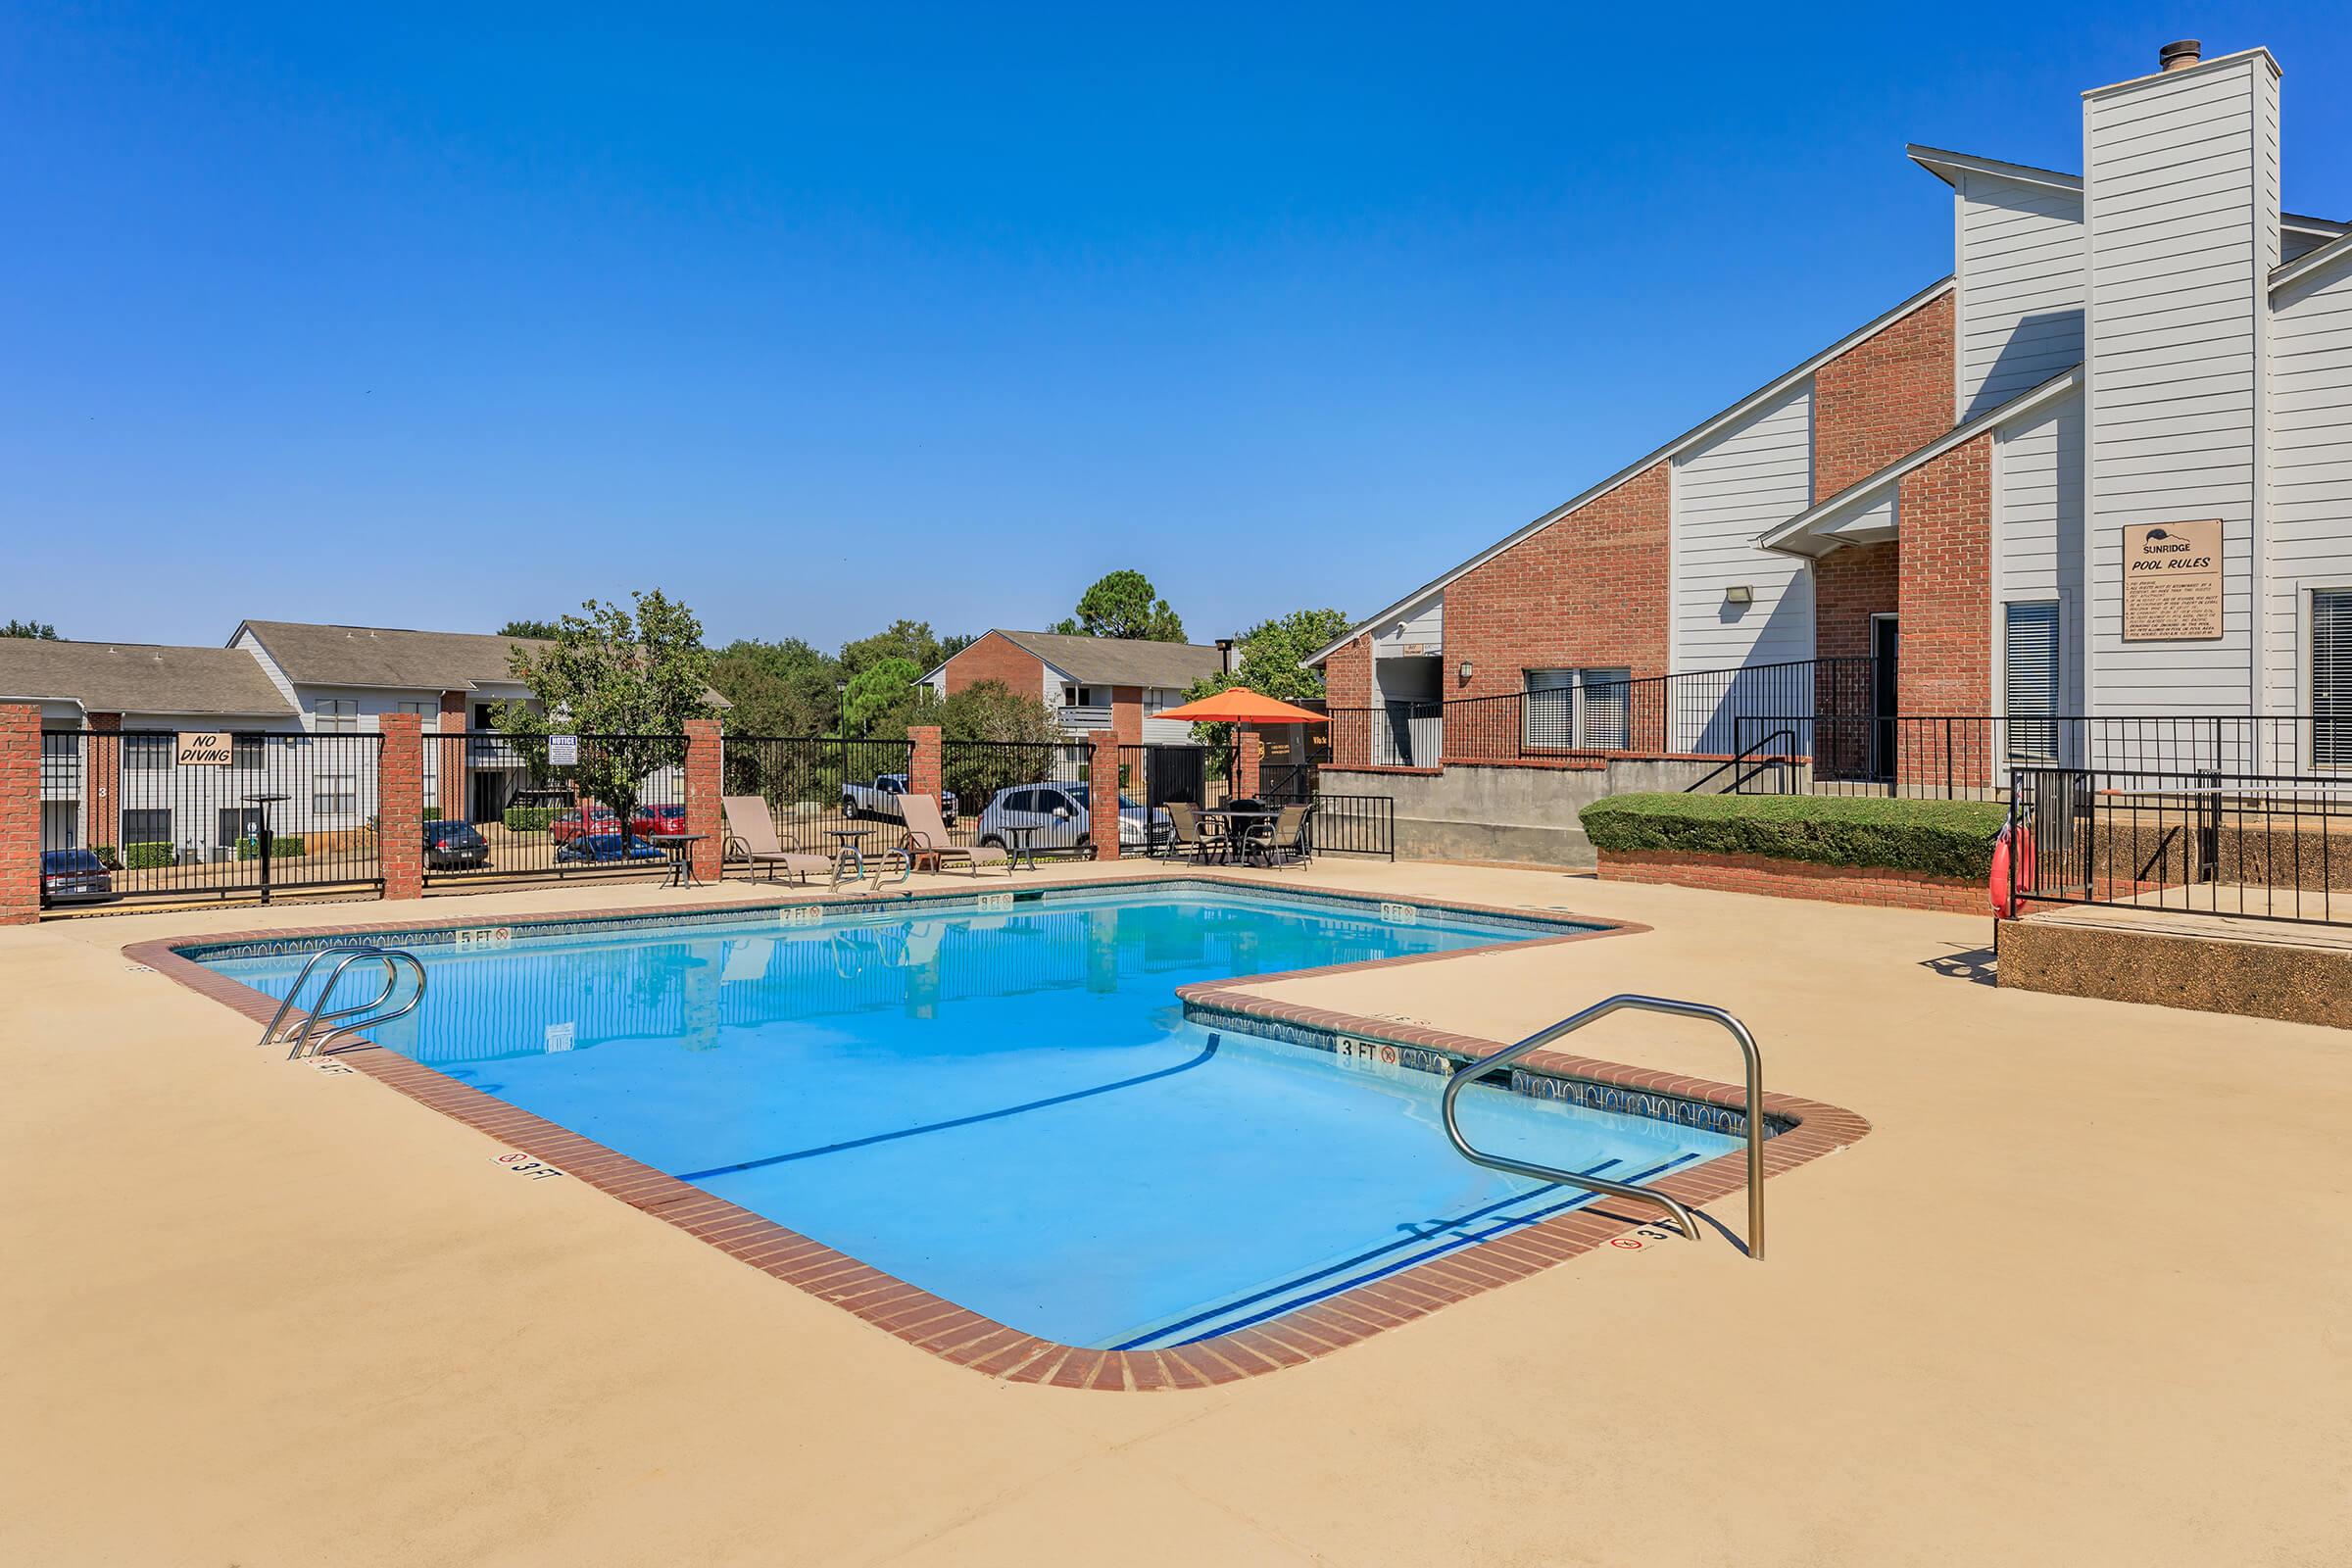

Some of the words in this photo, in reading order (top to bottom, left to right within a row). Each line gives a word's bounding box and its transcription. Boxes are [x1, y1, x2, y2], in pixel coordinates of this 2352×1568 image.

[2143, 544, 2190, 554] SUNRIDGE
[2132, 561, 2162, 570] POOL
[2168, 557, 2211, 568] RULES
[192, 735, 217, 748] NO
[180, 749, 230, 761] DIVING
[783, 909, 791, 919] 7
[796, 907, 808, 918] FT
[462, 931, 470, 943] 5
[476, 930, 492, 942] FT
[1343, 1040, 1352, 1055] 3
[1358, 1042, 1376, 1060] FT
[511, 1162, 541, 1171] 3
[522, 1168, 564, 1181] FT
[1637, 1230, 1669, 1240] 3
